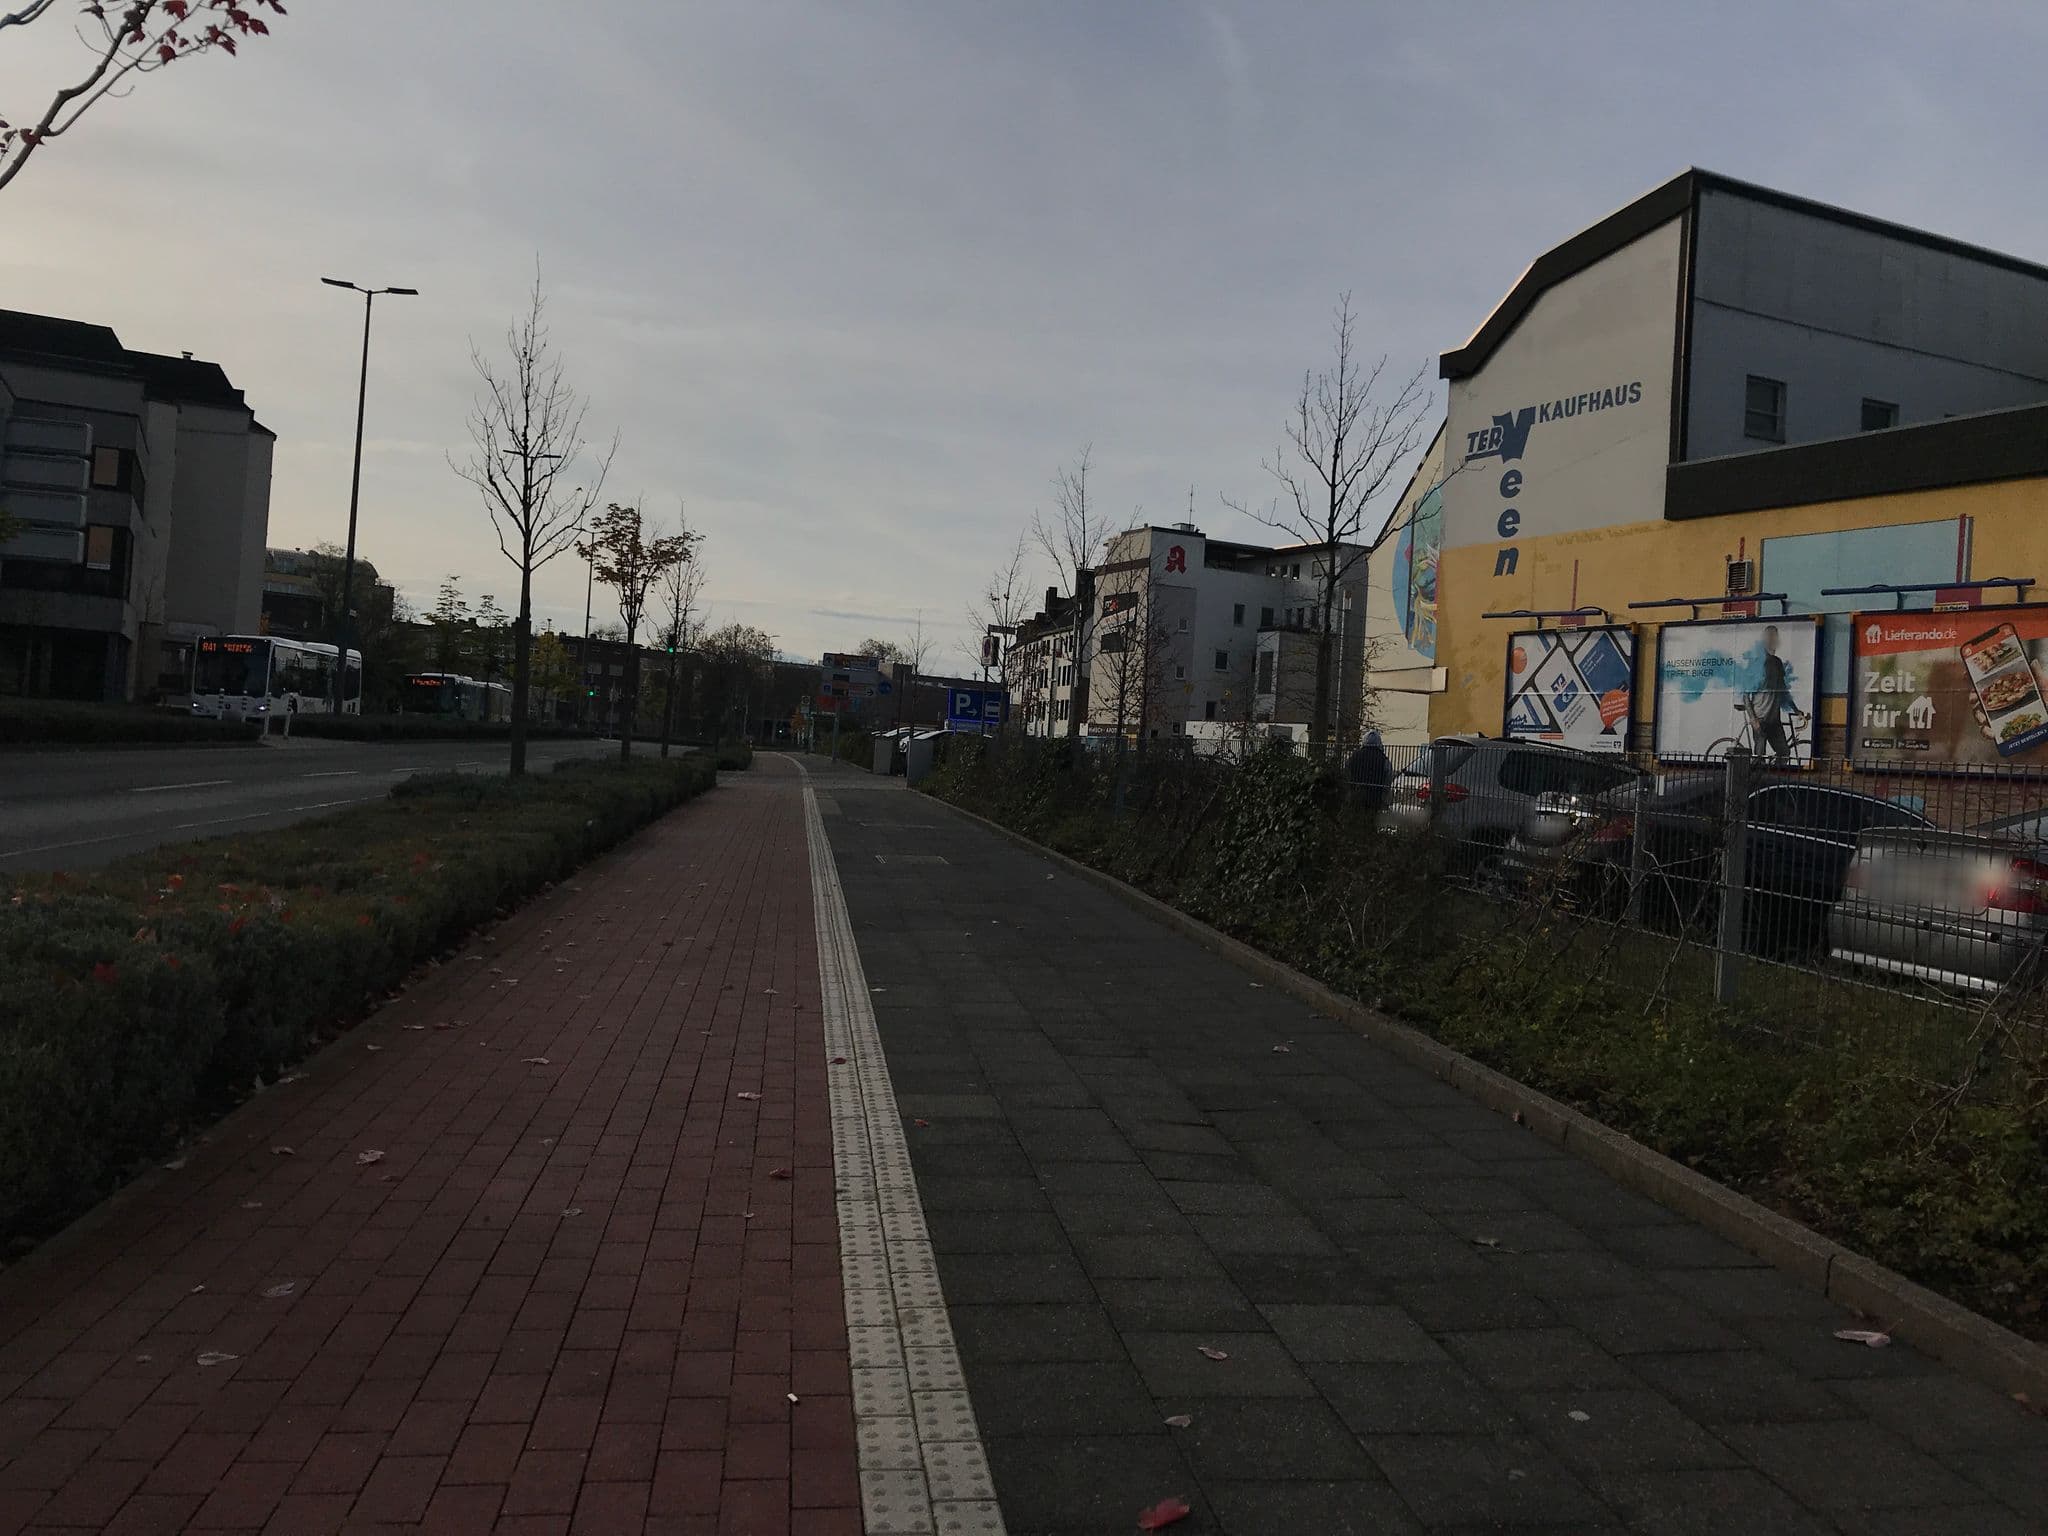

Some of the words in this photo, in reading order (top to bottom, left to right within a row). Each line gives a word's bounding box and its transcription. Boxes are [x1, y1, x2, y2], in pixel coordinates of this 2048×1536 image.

[1539, 382, 1642, 423] KAUFHAUS
[1467, 426, 1503, 453] TER
[1884, 628, 1957, 641] Lieferando.de
[1666, 657, 1734, 667] AUSSENWERBUNG
[1691, 668, 1714, 677] BIKER
[1863, 671, 1916, 693] Zeit
[954, 693, 971, 715] P
[1862, 703, 1901, 728] für
